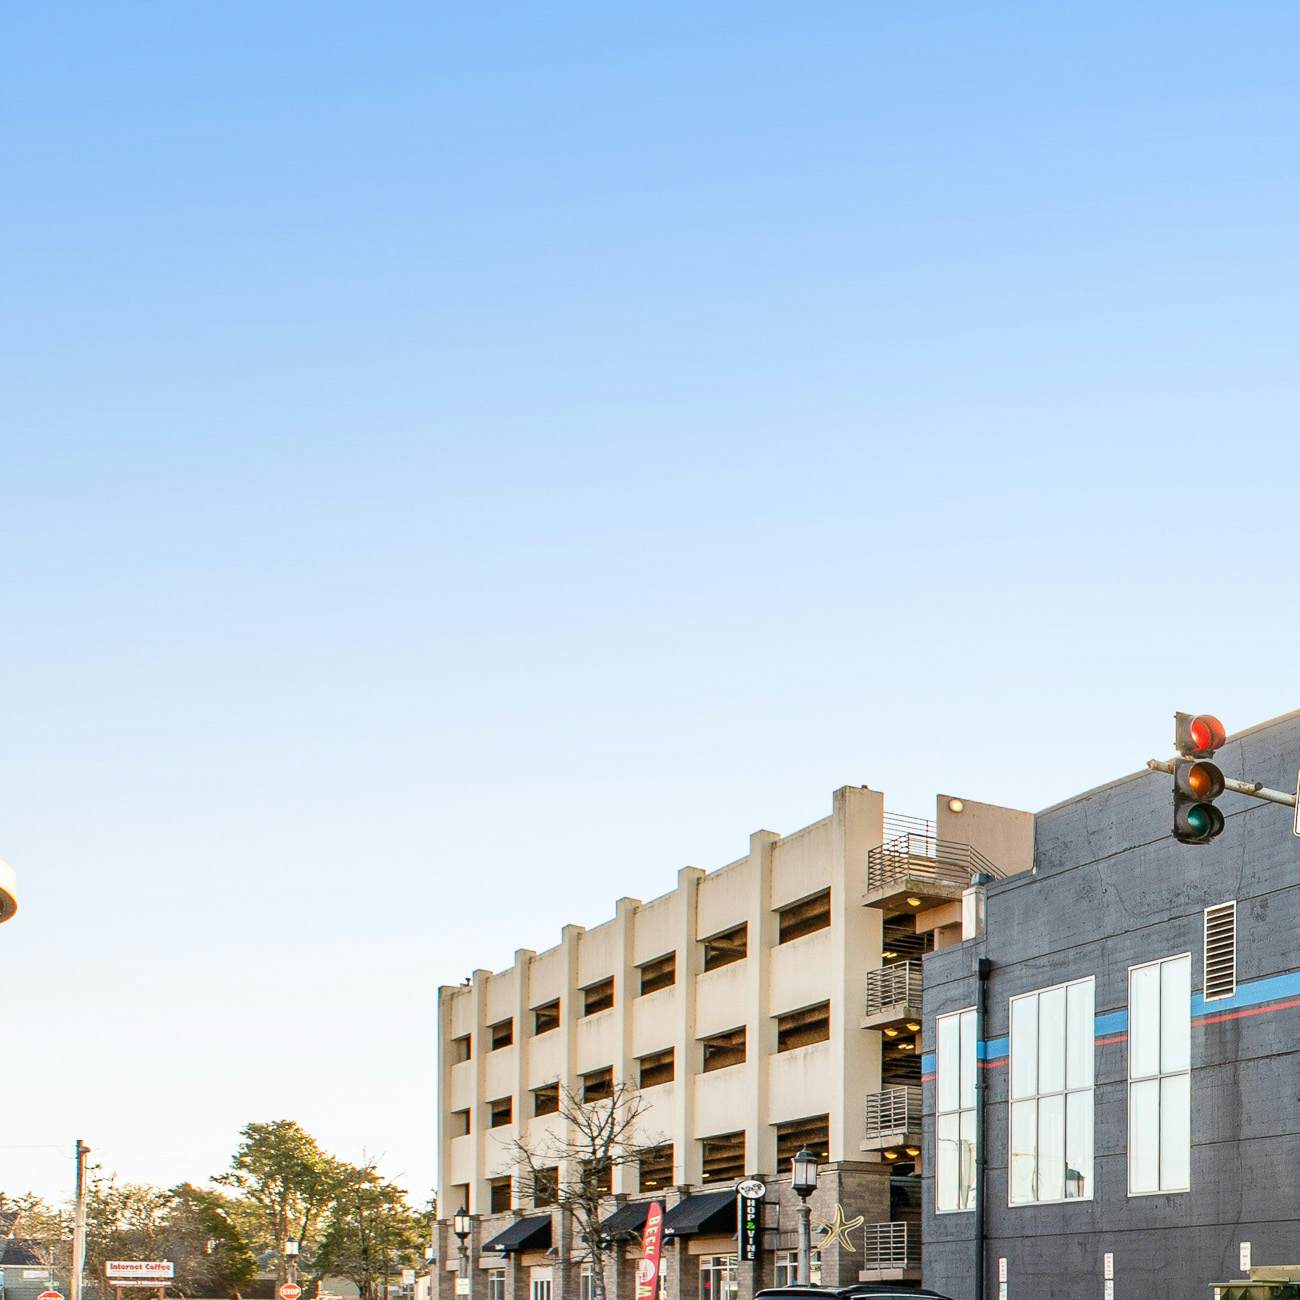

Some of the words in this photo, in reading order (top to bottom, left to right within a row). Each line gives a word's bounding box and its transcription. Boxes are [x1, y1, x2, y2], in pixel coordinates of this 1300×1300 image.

[747, 1200, 755, 1220] HOP
[746, 1222, 756, 1230] &
[747, 1230, 755, 1259] VINE
[110, 1262, 142, 1270] Internet
[145, 1262, 171, 1270] Coffee
